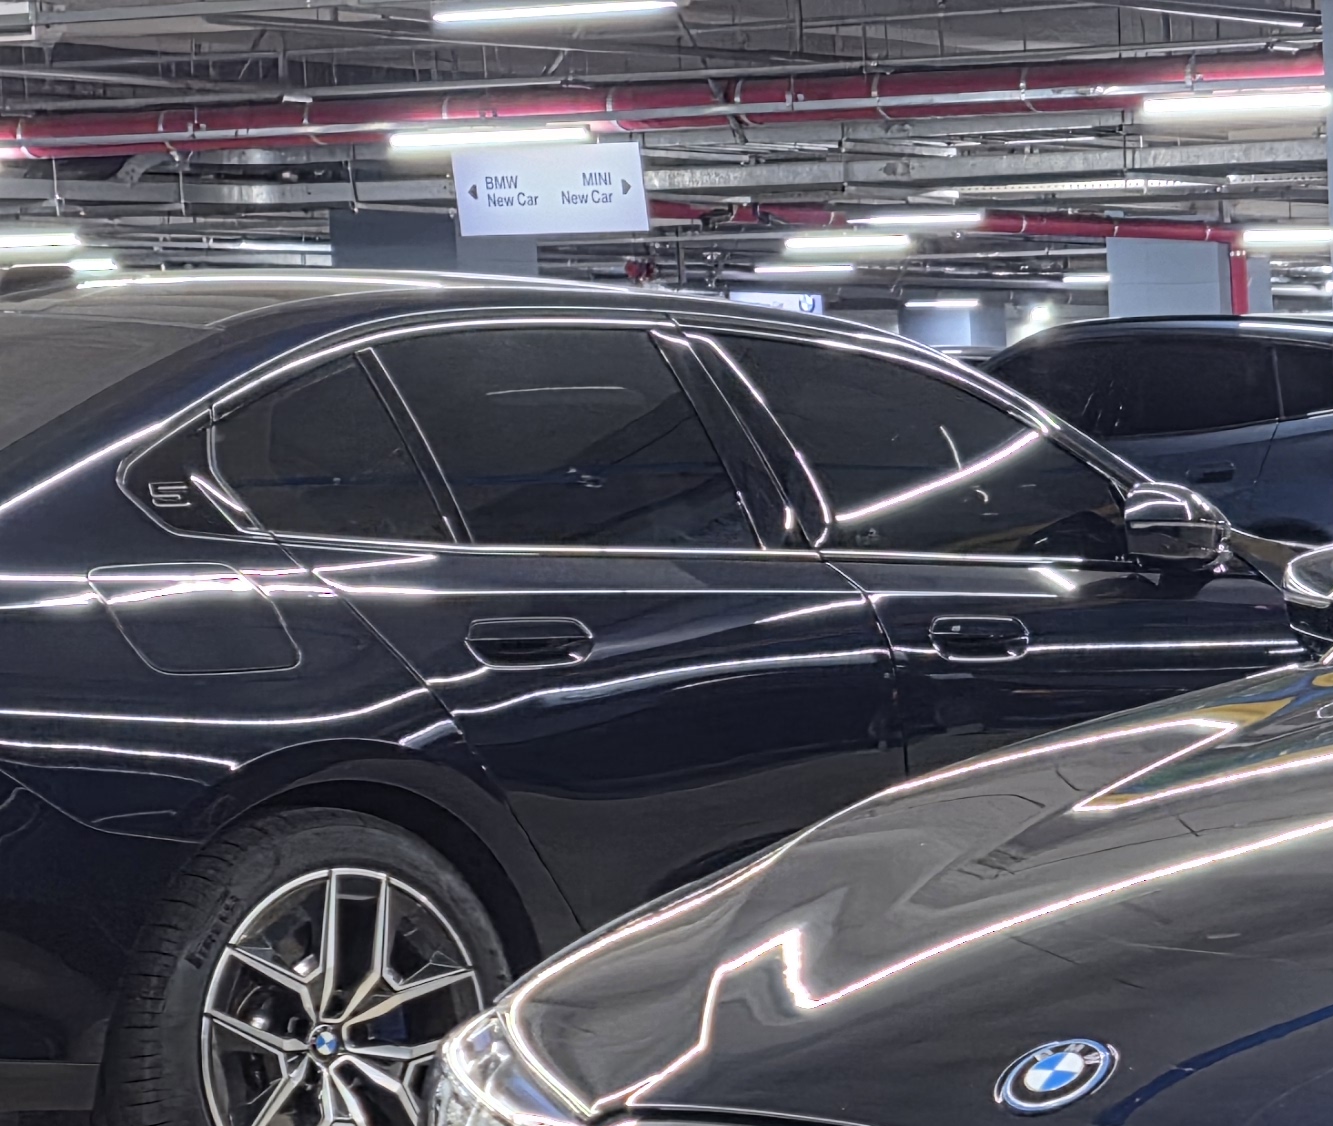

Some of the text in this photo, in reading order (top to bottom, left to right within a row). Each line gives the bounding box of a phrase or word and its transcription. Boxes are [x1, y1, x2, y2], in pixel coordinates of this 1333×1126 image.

[485, 175, 518, 190] BMW
[582, 172, 612, 186] MINI
[487, 192, 539, 207] New Car
[561, 189, 613, 205] New Car
